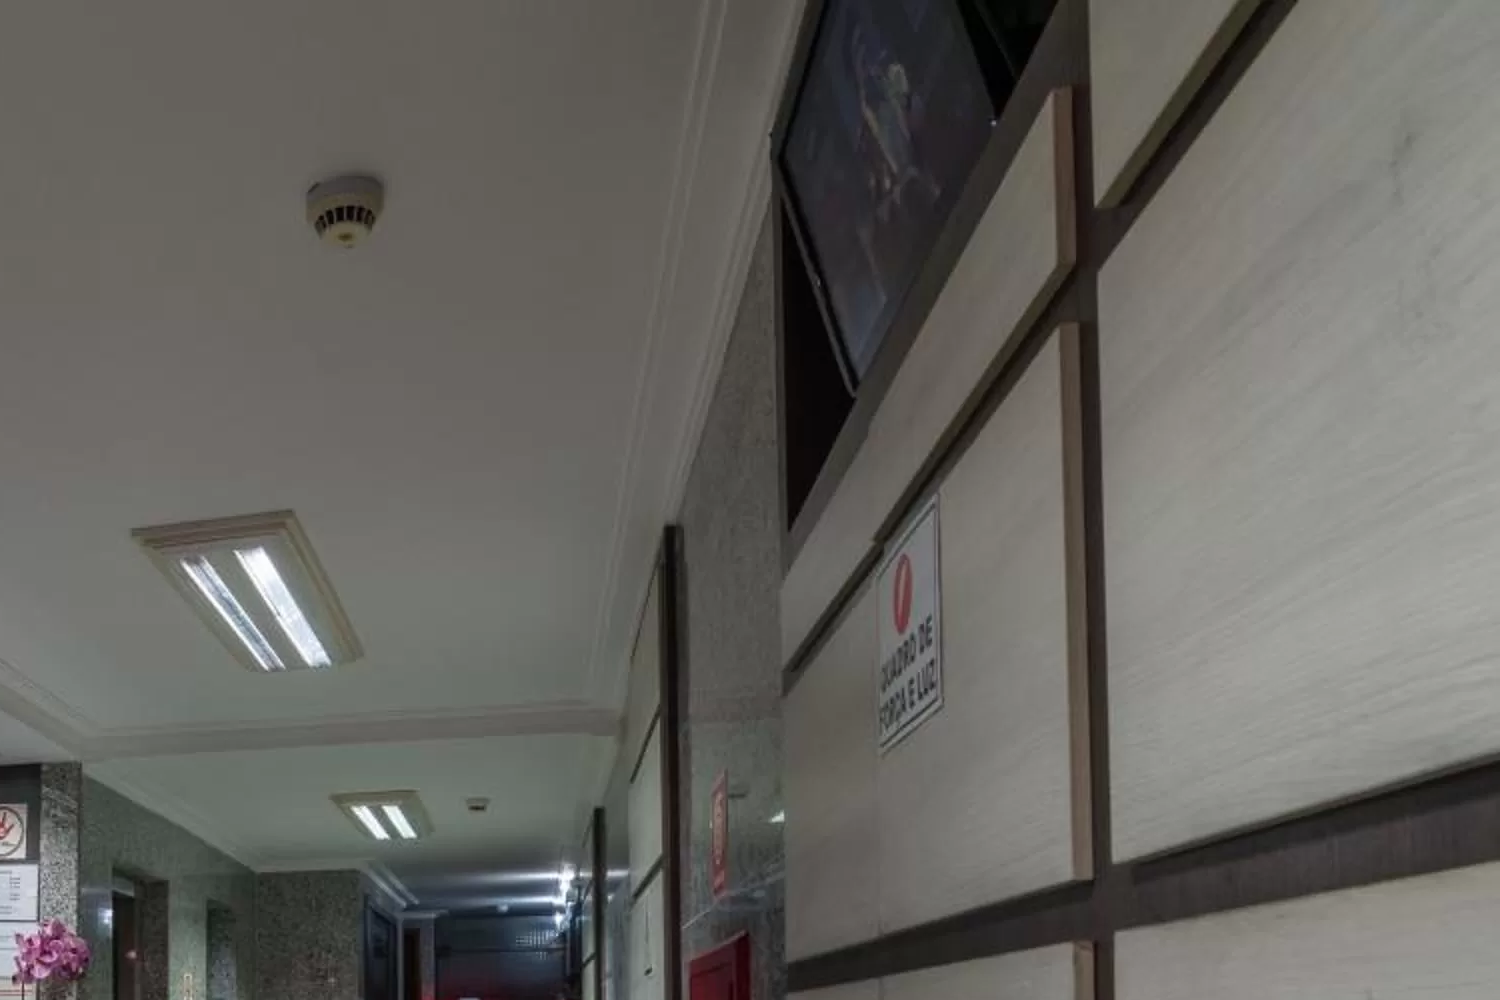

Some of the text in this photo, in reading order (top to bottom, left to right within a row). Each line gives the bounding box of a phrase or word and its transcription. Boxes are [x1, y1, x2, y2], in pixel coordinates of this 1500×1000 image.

[919, 613, 933, 654] DE
[909, 677, 916, 709] E
[918, 658, 936, 700] LUZ
